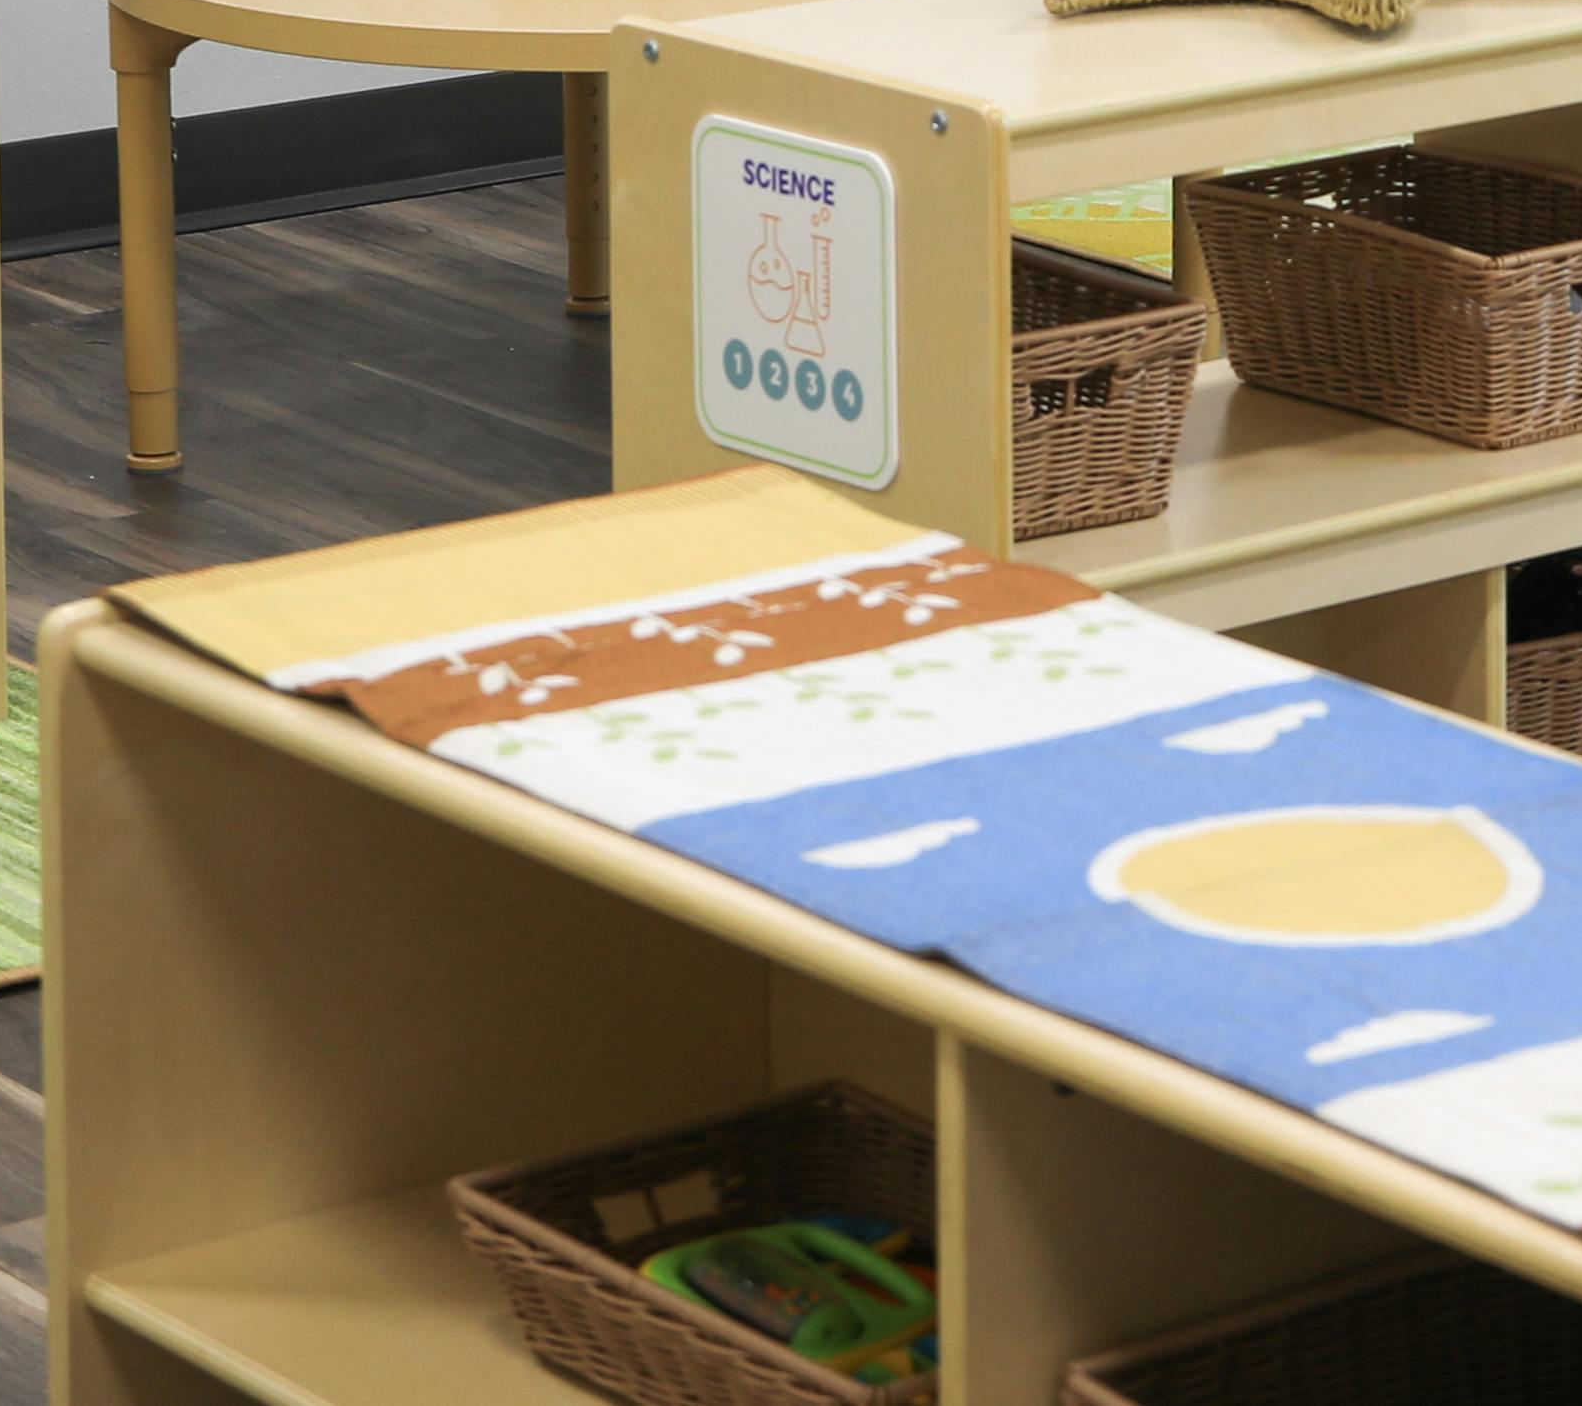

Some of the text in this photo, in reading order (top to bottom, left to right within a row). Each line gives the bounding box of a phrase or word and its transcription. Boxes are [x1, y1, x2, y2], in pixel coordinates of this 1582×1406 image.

[743, 158, 835, 206] SCIENCE
[733, 353, 856, 407] 1 2 3 4
